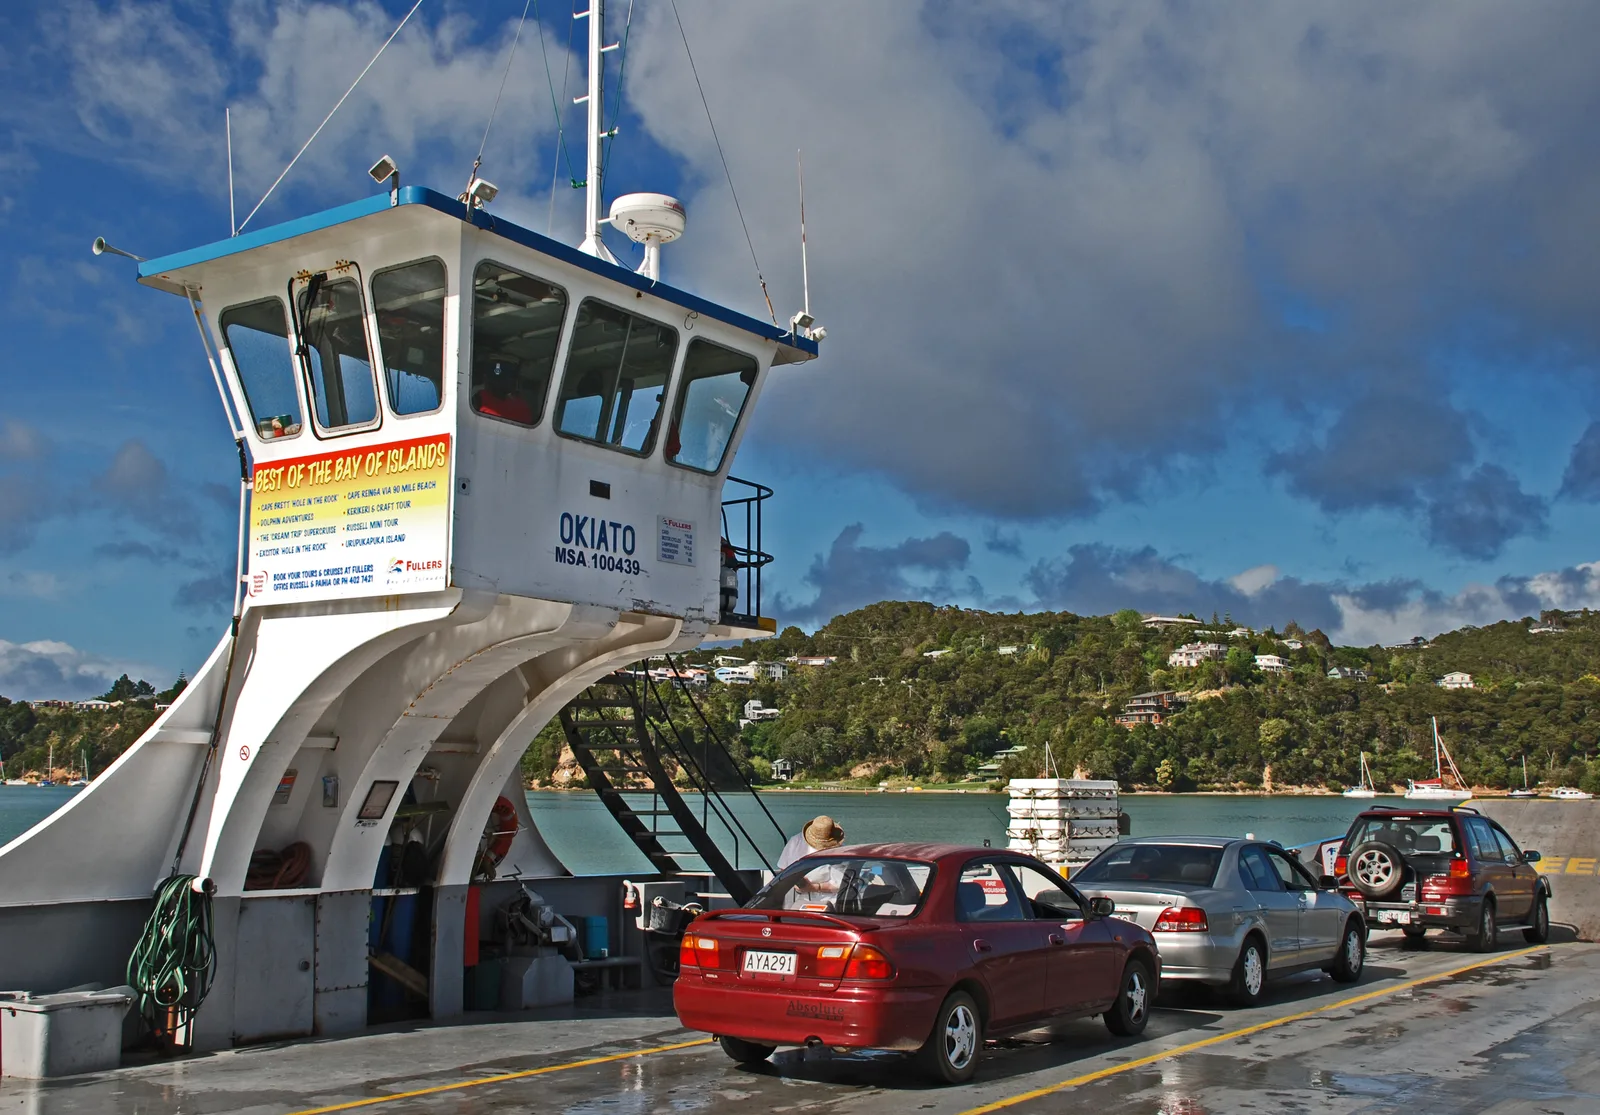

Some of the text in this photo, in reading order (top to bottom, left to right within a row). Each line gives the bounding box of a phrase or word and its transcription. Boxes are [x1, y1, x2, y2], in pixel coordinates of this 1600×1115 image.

[255, 442, 445, 493] BEST OF THE BAY OF ISLANDS
[348, 481, 436, 500] CAPE REINGA VIA 90 MILE BEACH
[261, 502, 273, 511] CAPE
[274, 500, 290, 510] BRETT
[307, 497, 312, 506] IN
[314, 496, 323, 504] THE
[347, 506, 370, 516] KERIKERI
[376, 502, 394, 512] CRAFT
[396, 500, 411, 510] TOUR
[260, 513, 314, 526] DOLPHIN ADVENTURES
[346, 518, 398, 532] RUSSELL MINI TOUR
[260, 534, 268, 542] THE
[304, 526, 336, 537] SUPERCRUISE
[346, 534, 406, 548] URUPUKAPUKA ISLAND
[560, 512, 635, 556] OKIATO
[260, 548, 280, 557] EXCITOR
[296, 545, 300, 553] IN
[302, 544, 310, 552] THE
[592, 553, 640, 576] 100439
[274, 573, 286, 582] BOOK
[288, 571, 301, 580] YOUR
[302, 570, 317, 578] TOURS
[324, 567, 343, 576] CRUISES
[344, 566, 350, 574] AT
[352, 564, 374, 574] FULLERS
[274, 582, 288, 591] OFFICE
[290, 581, 309, 590] RUSSELL
[310, 580, 314, 588] &
[333, 578, 340, 586] OR
[341, 576, 348, 584] PH
[349, 575, 360, 584] 402
[746, 954, 792, 972] AYA291
[788, 1000, 844, 1015] Absolute
